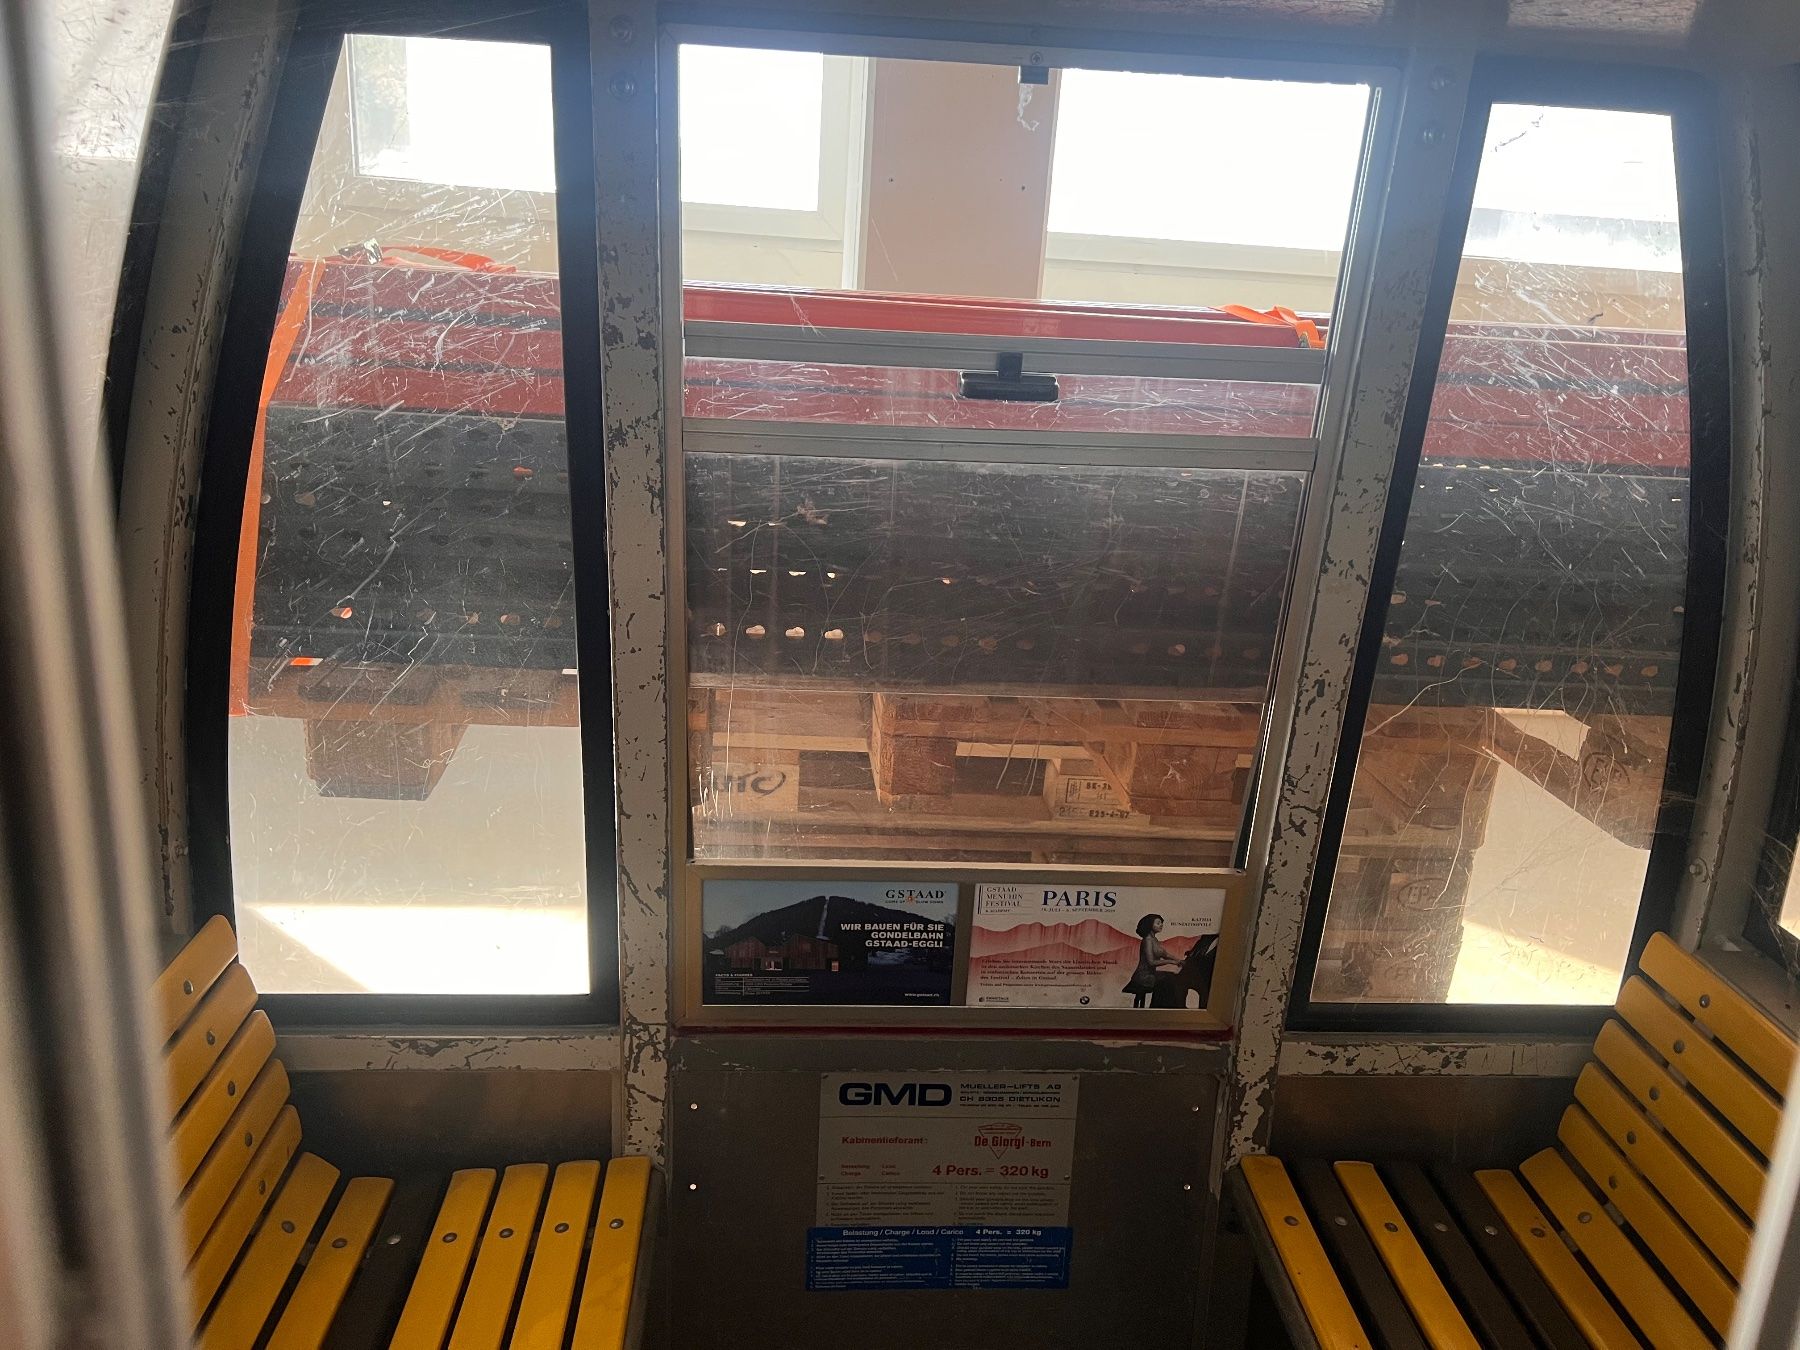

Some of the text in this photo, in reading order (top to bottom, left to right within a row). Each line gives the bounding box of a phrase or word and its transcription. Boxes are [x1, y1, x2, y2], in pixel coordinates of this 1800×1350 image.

[885, 889, 945, 899] GSTAAD
[1042, 890, 1117, 908] PARIS
[840, 923, 861, 931] WIR
[864, 923, 900, 931] BAUEN
[903, 921, 924, 931] FÜR
[871, 931, 944, 940] GONDELBAHN
[865, 939, 943, 948] GSTAAD-EGGLI
[838, 1082, 953, 1107] GMD
[974, 1135, 989, 1147] De
[991, 1135, 1025, 1149] Giorgi
[1030, 1138, 1051, 1147] Bern
[932, 1164, 942, 1176] 4
[946, 1164, 982, 1176] Pers.
[999, 1165, 1028, 1176] 320
[1031, 1165, 1049, 1179] kg
[842, 1229, 879, 1237] Belastung
